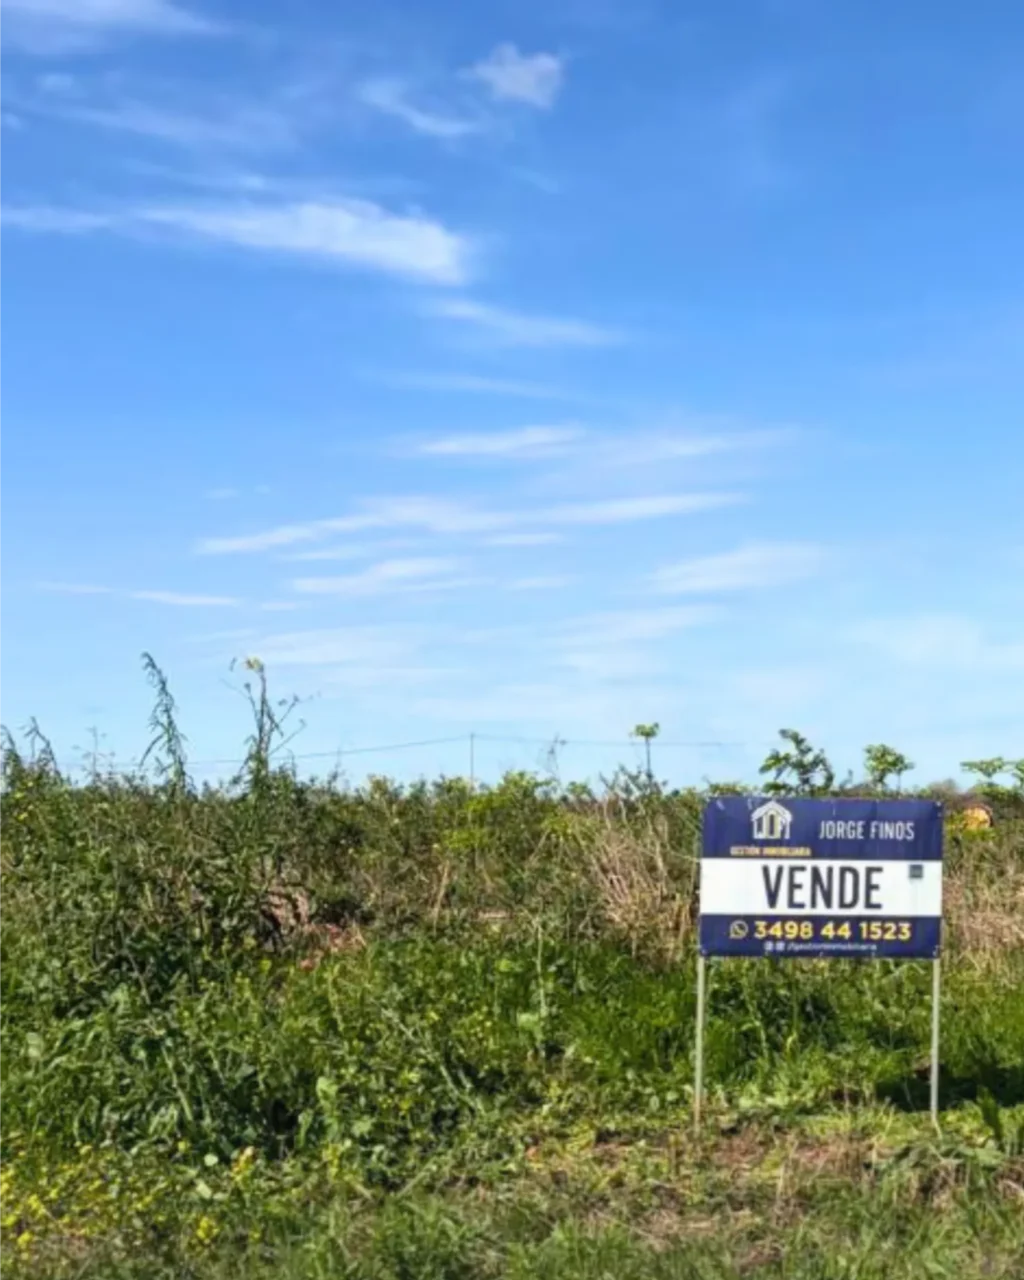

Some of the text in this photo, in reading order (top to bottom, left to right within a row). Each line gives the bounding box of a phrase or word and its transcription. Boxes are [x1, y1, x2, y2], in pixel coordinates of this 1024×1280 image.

[819, 820, 915, 841] JORGE FINOS
[762, 865, 883, 909] VENDE
[754, 920, 911, 940] 3498 44 1523
